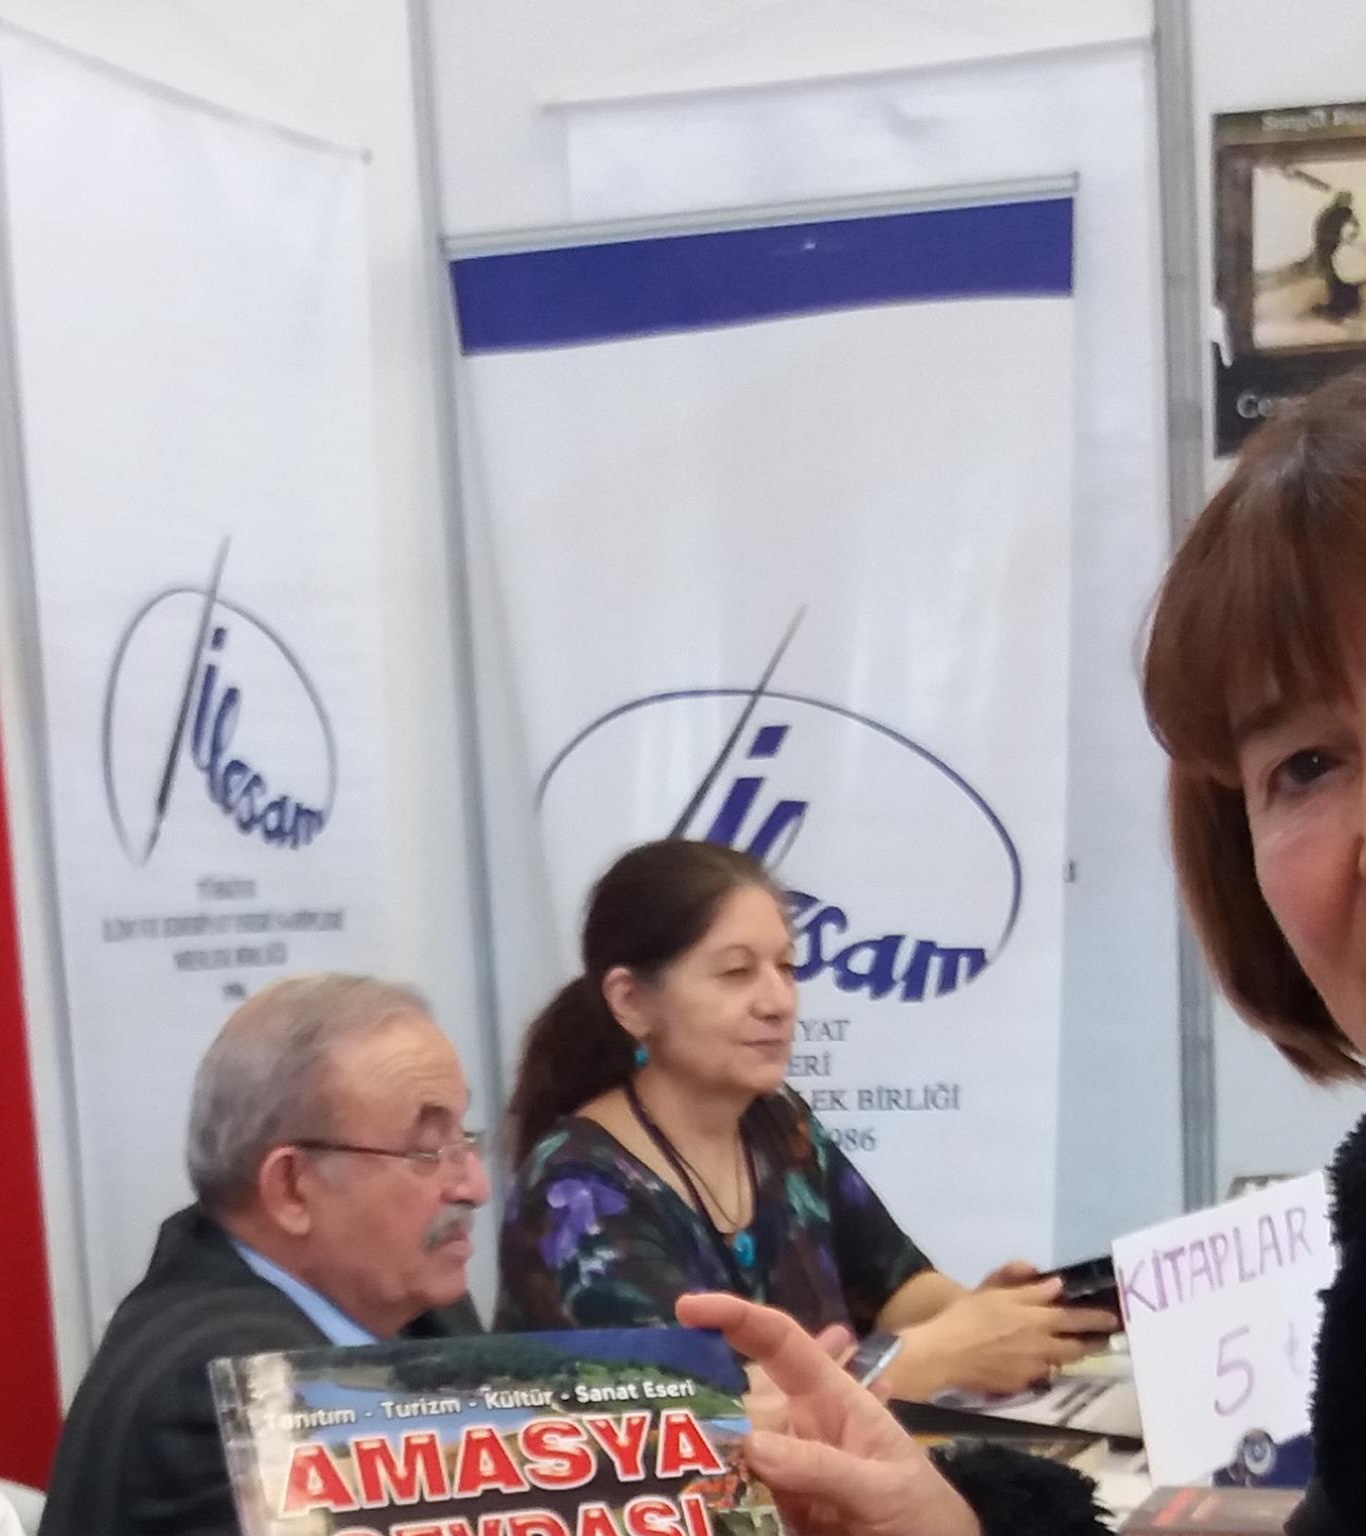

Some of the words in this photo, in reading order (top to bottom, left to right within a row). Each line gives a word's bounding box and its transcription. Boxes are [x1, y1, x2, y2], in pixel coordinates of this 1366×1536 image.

[786, 1049, 833, 1078] ERİ
[857, 1081, 962, 1113] BİRLİĞİ
[826, 1125, 878, 1153] 986
[1214, 1325, 1255, 1417] 5
[380, 1397, 462, 1420] Turizm
[484, 1384, 555, 1410] Kültür
[574, 1383, 637, 1404] Sanat
[642, 1378, 696, 1399] Eseri
[278, 1408, 725, 1520] AMASYA
